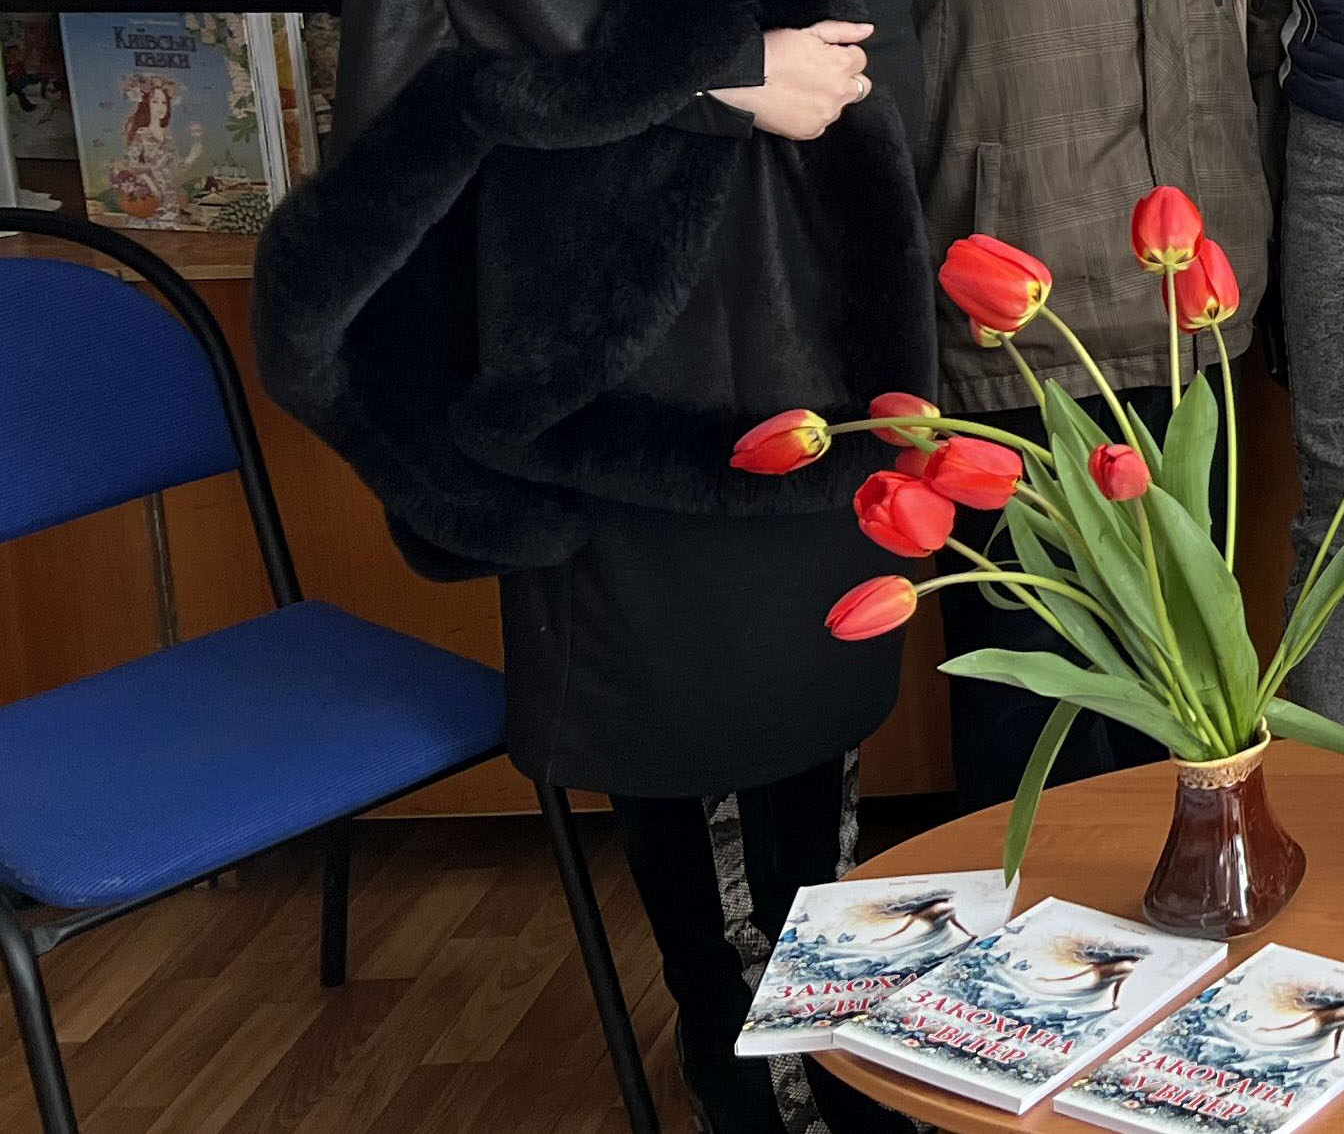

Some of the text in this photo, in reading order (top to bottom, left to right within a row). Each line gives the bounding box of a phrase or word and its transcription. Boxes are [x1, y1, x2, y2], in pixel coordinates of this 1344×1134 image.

[113, 26, 196, 52] Київські
[802, 997, 828, 1016] У
[905, 988, 1075, 1058] ЗАКОХАНА
[908, 1012, 1027, 1065] У ВІТЕР
[1126, 1047, 1298, 1109] ЗАКОХАНА
[1129, 1073, 1248, 1122] У ВІТЕР
